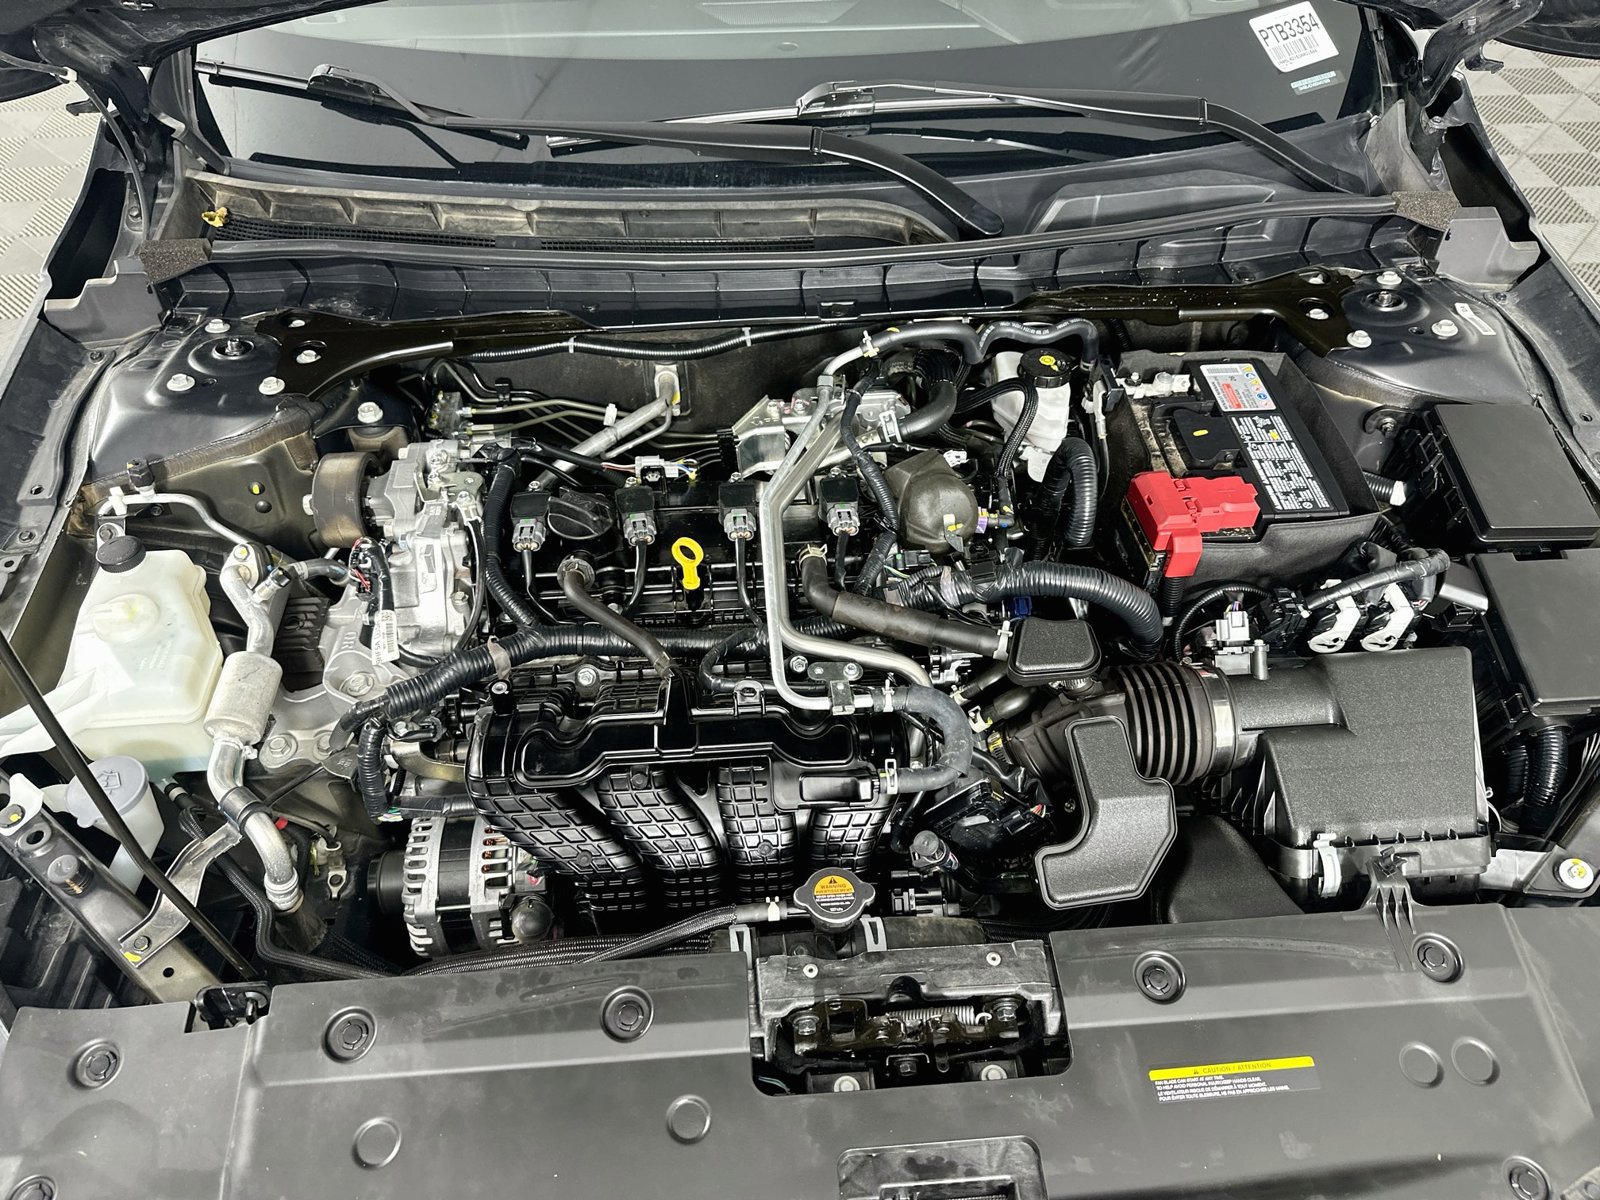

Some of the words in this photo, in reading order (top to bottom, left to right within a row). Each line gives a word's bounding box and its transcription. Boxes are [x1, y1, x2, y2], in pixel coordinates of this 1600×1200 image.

[1258, 13, 1320, 47] PTB3354
[1203, 1065, 1231, 1074] CAUTION
[1237, 1062, 1272, 1071] ATTENTION
